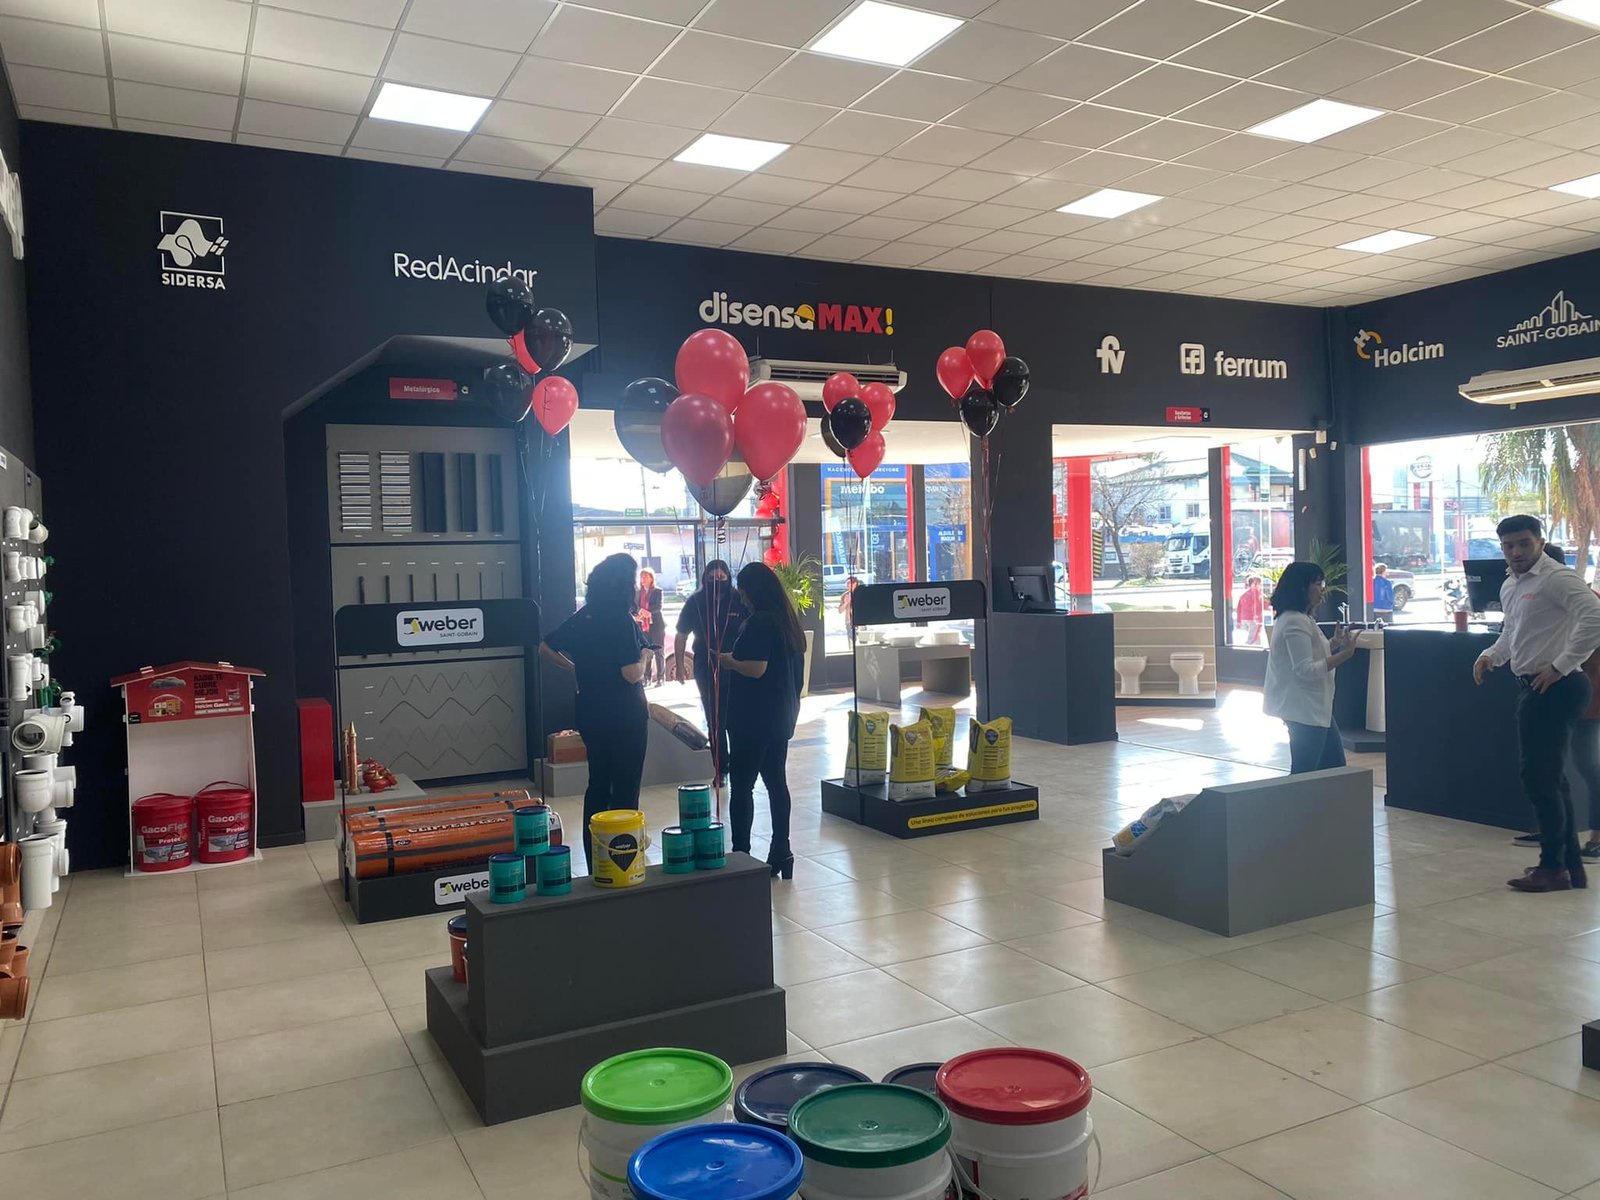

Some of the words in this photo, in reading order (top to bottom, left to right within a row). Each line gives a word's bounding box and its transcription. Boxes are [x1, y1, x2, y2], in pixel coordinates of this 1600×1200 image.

[161, 272, 226, 290] SIDERSA
[1374, 340, 1445, 368] Holcim
[1214, 350, 1287, 379] ferrum
[908, 593, 946, 607] weber
[418, 616, 477, 632] weber
[451, 878, 490, 892] webe
